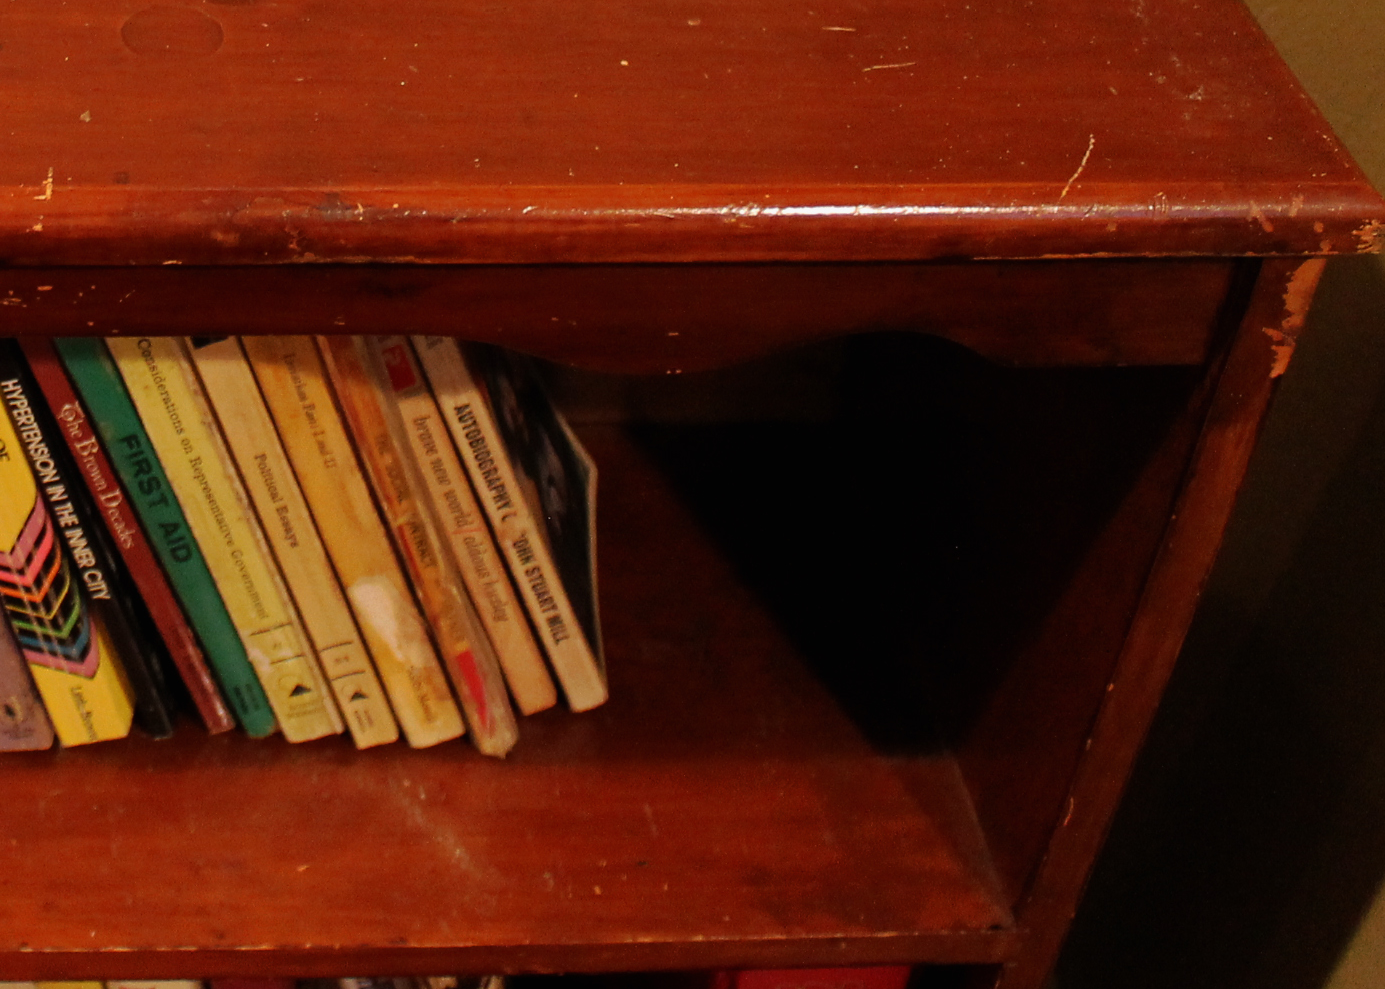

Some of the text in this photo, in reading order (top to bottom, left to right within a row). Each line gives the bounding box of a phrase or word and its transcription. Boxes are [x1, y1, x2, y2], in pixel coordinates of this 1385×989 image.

[0, 378, 111, 601] HYPERTENSION IN THE INNER CITY
[58, 400, 136, 549] The Brown Decades
[119, 433, 193, 565] FIRST AID
[137, 337, 269, 620] Considerations on Representative Government
[255, 452, 299, 549] Political Essays
[413, 414, 437, 457] brave
[430, 457, 451, 487] new
[463, 535, 490, 580] aldous
[454, 402, 514, 511] AUTOBIOGRAPHY
[524, 566, 559, 614] STUART
[545, 614, 571, 646] MILL
